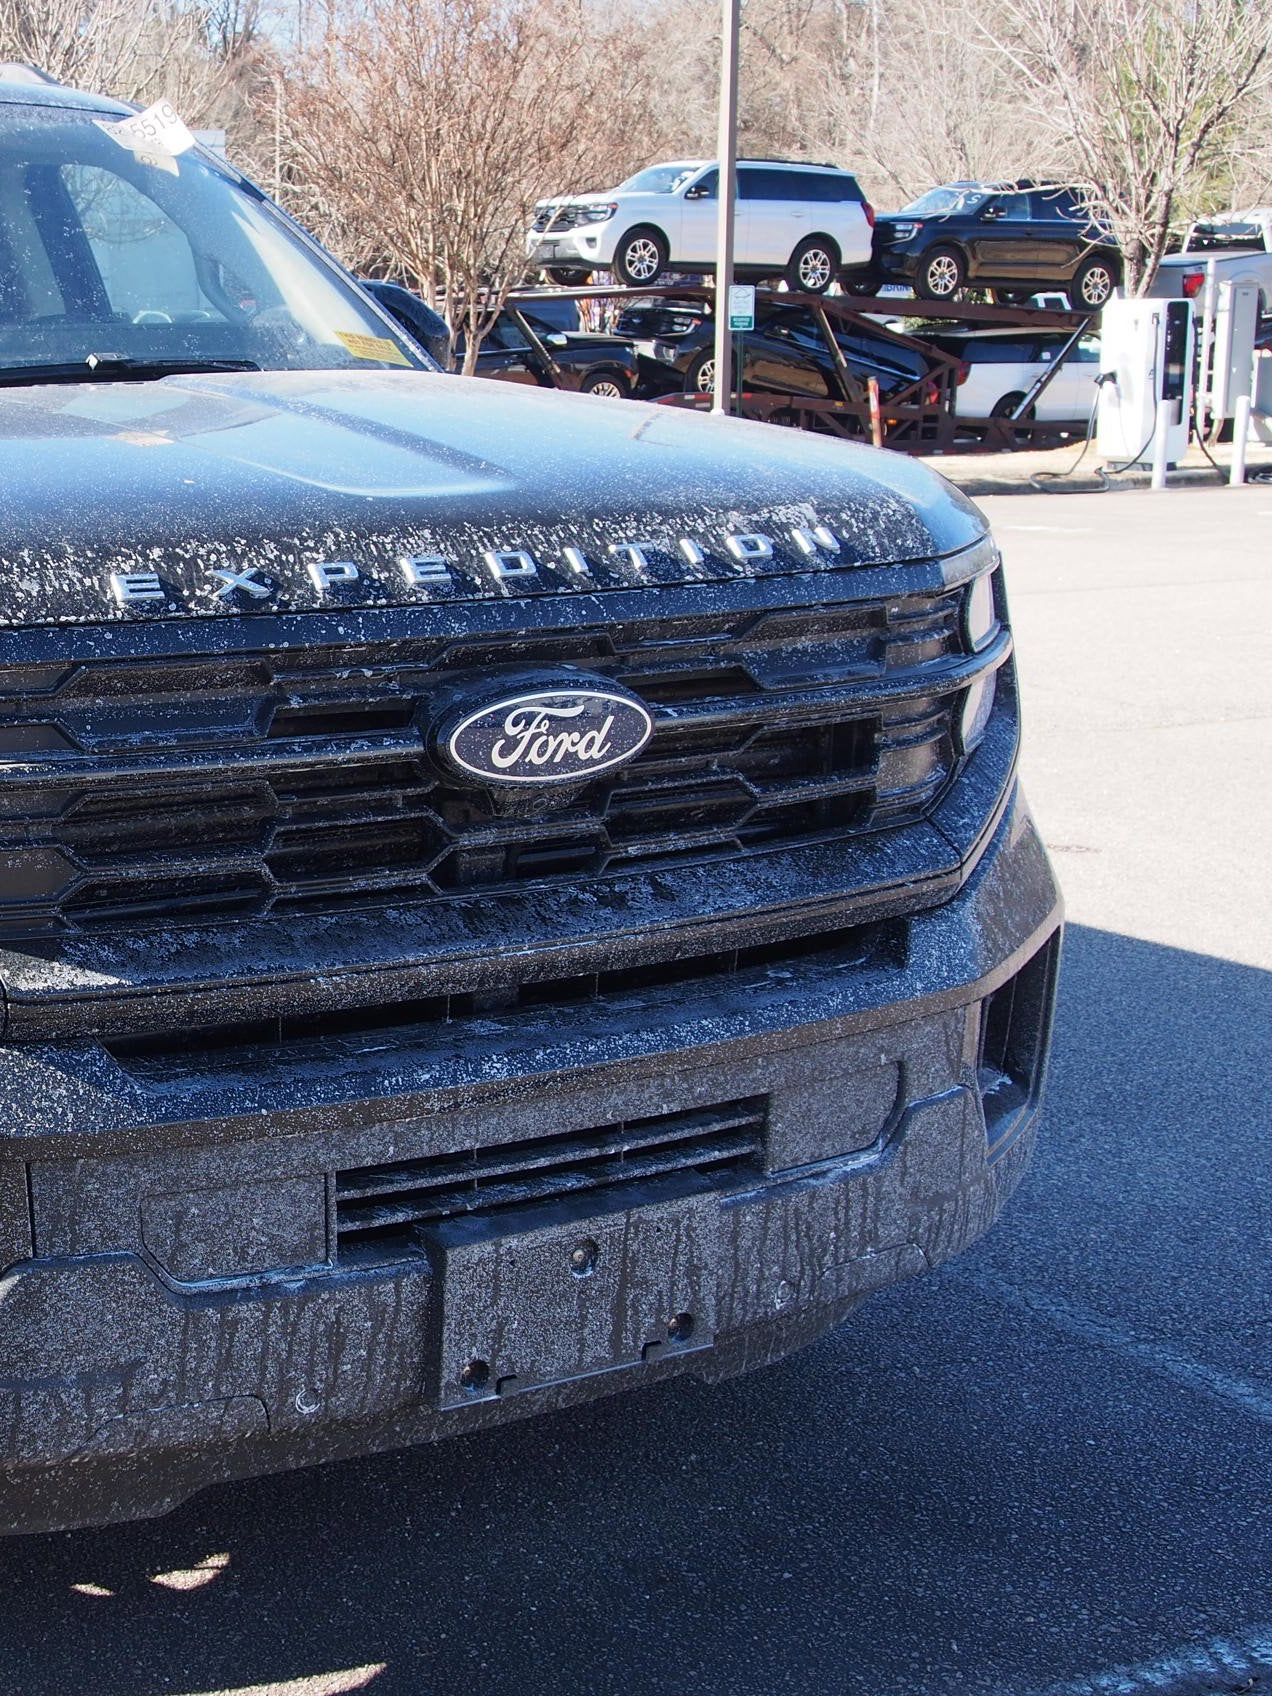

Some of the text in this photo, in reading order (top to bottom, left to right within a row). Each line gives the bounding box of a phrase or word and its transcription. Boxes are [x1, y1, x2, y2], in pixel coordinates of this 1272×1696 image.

[129, 104, 178, 138] 5519
[110, 526, 840, 602] EXPEDITION
[491, 705, 615, 768] Ford
